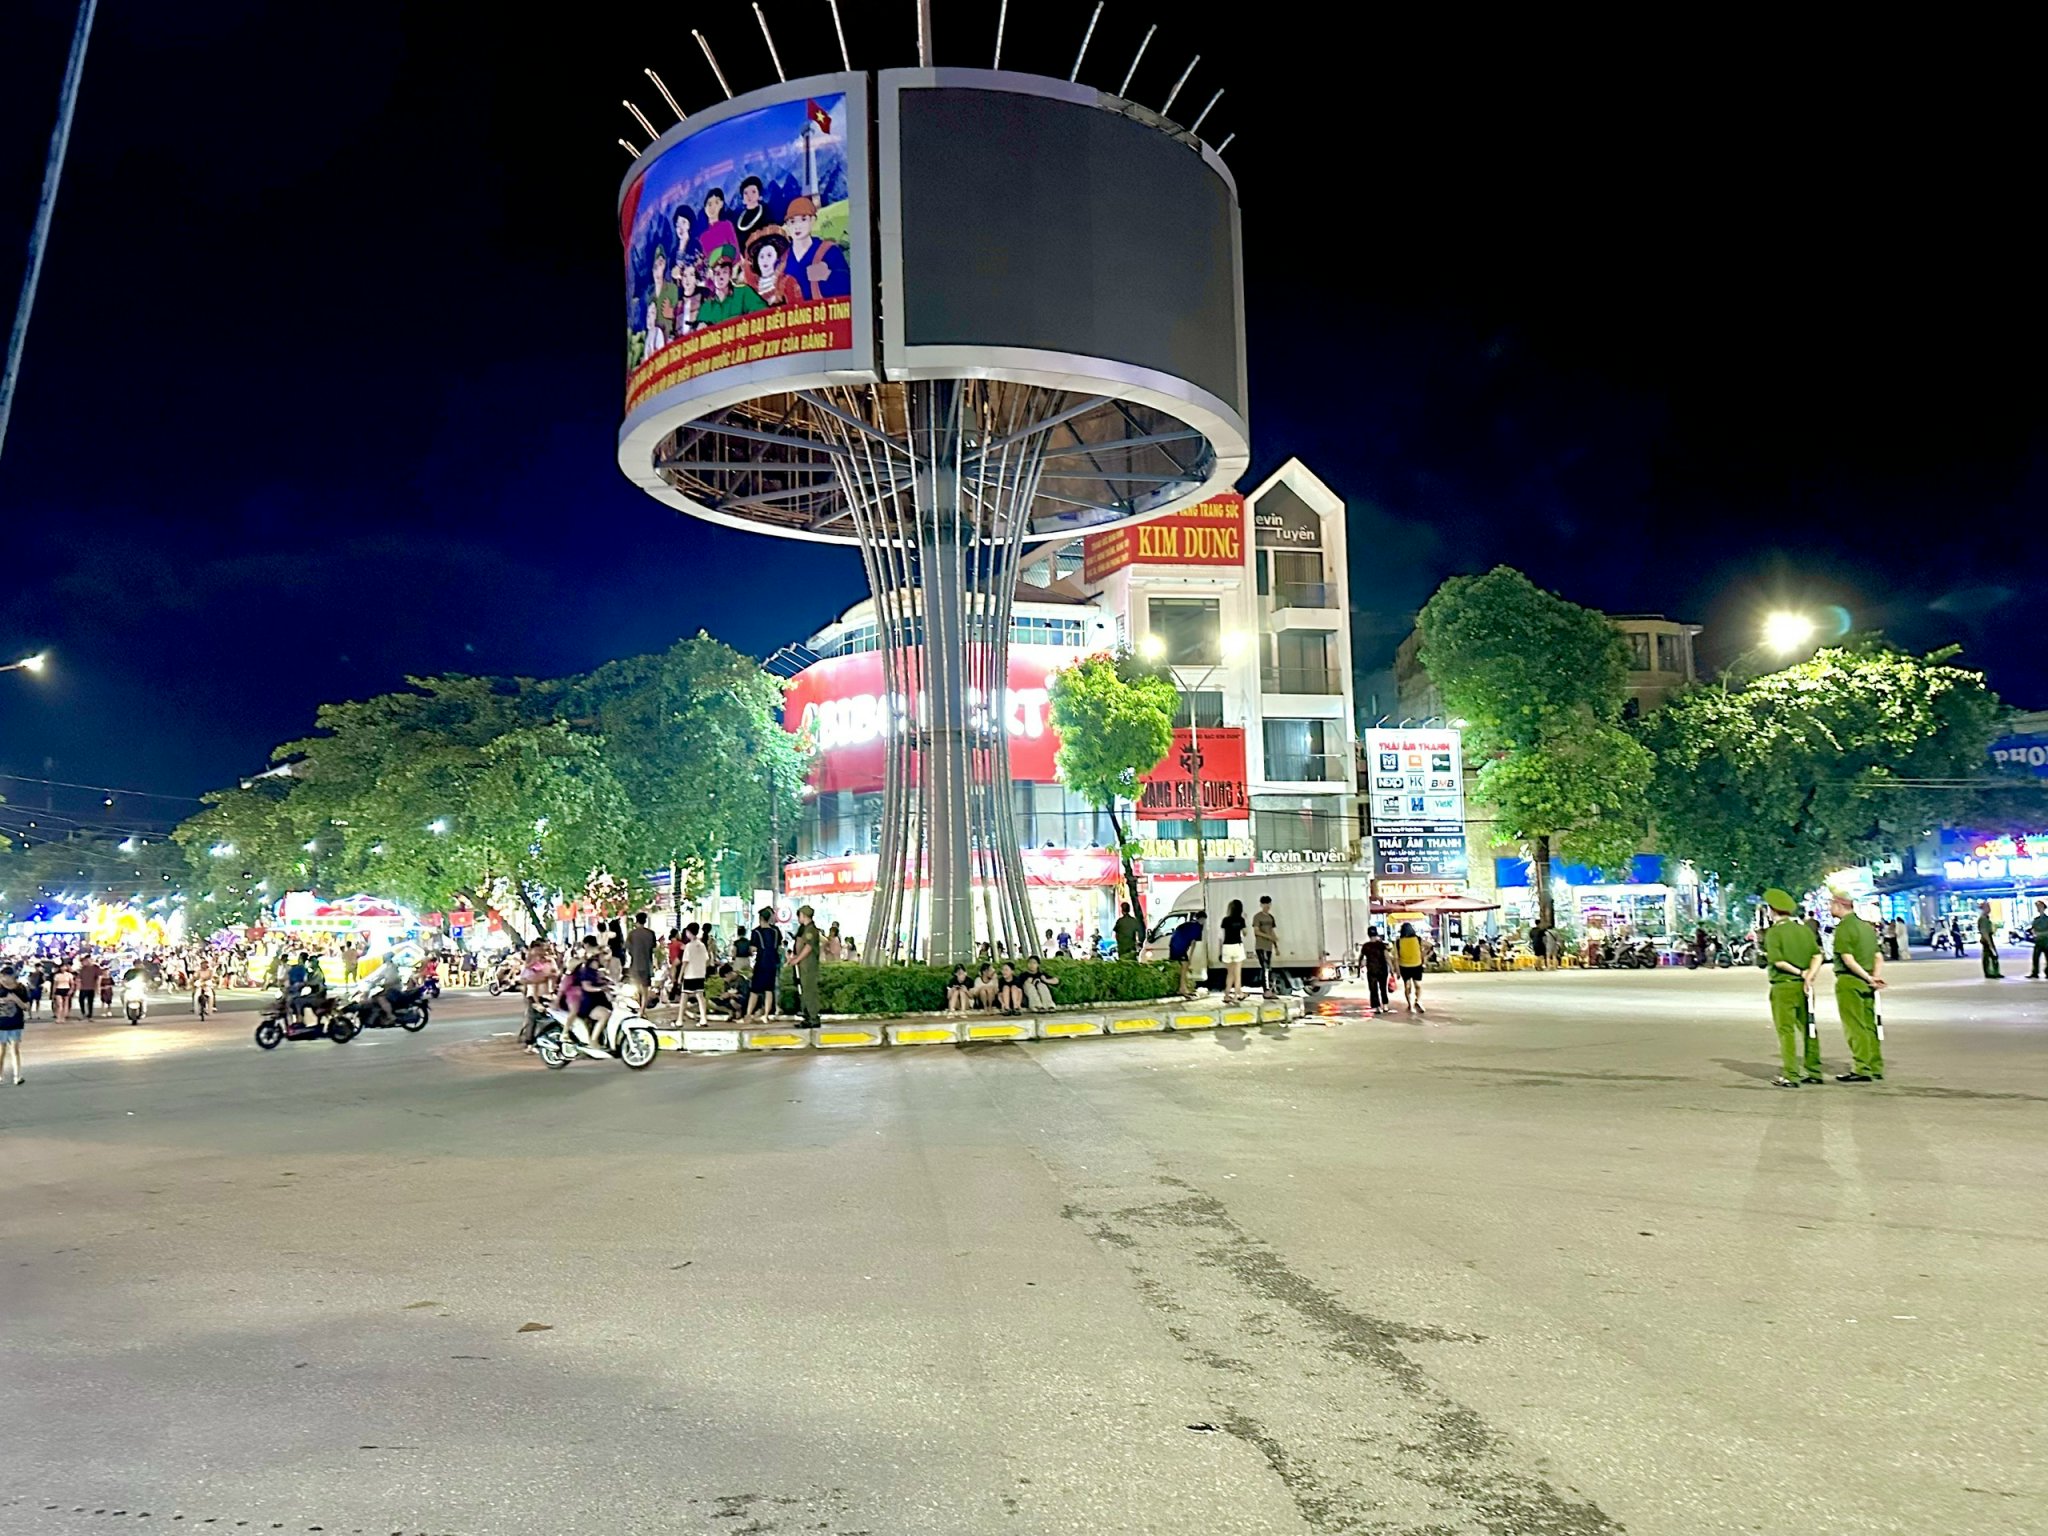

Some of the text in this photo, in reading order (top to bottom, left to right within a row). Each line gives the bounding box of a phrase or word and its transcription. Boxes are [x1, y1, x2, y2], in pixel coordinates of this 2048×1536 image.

[1200, 503, 1224, 517] TRANG
[1255, 513, 1283, 526] evin
[1276, 525, 1315, 542] Tuyền
[1138, 526, 1178, 557] KIM
[1184, 526, 1239, 559] DUNG
[1993, 746, 2048, 766] PHO
[1432, 779, 1454, 787] BMB
[1203, 781, 1233, 807] DUNG
[1237, 781, 1244, 807] 3
[1378, 837, 1461, 848] THÁI ÂM THANH
[1262, 847, 1346, 865] Kevin Tuyền
